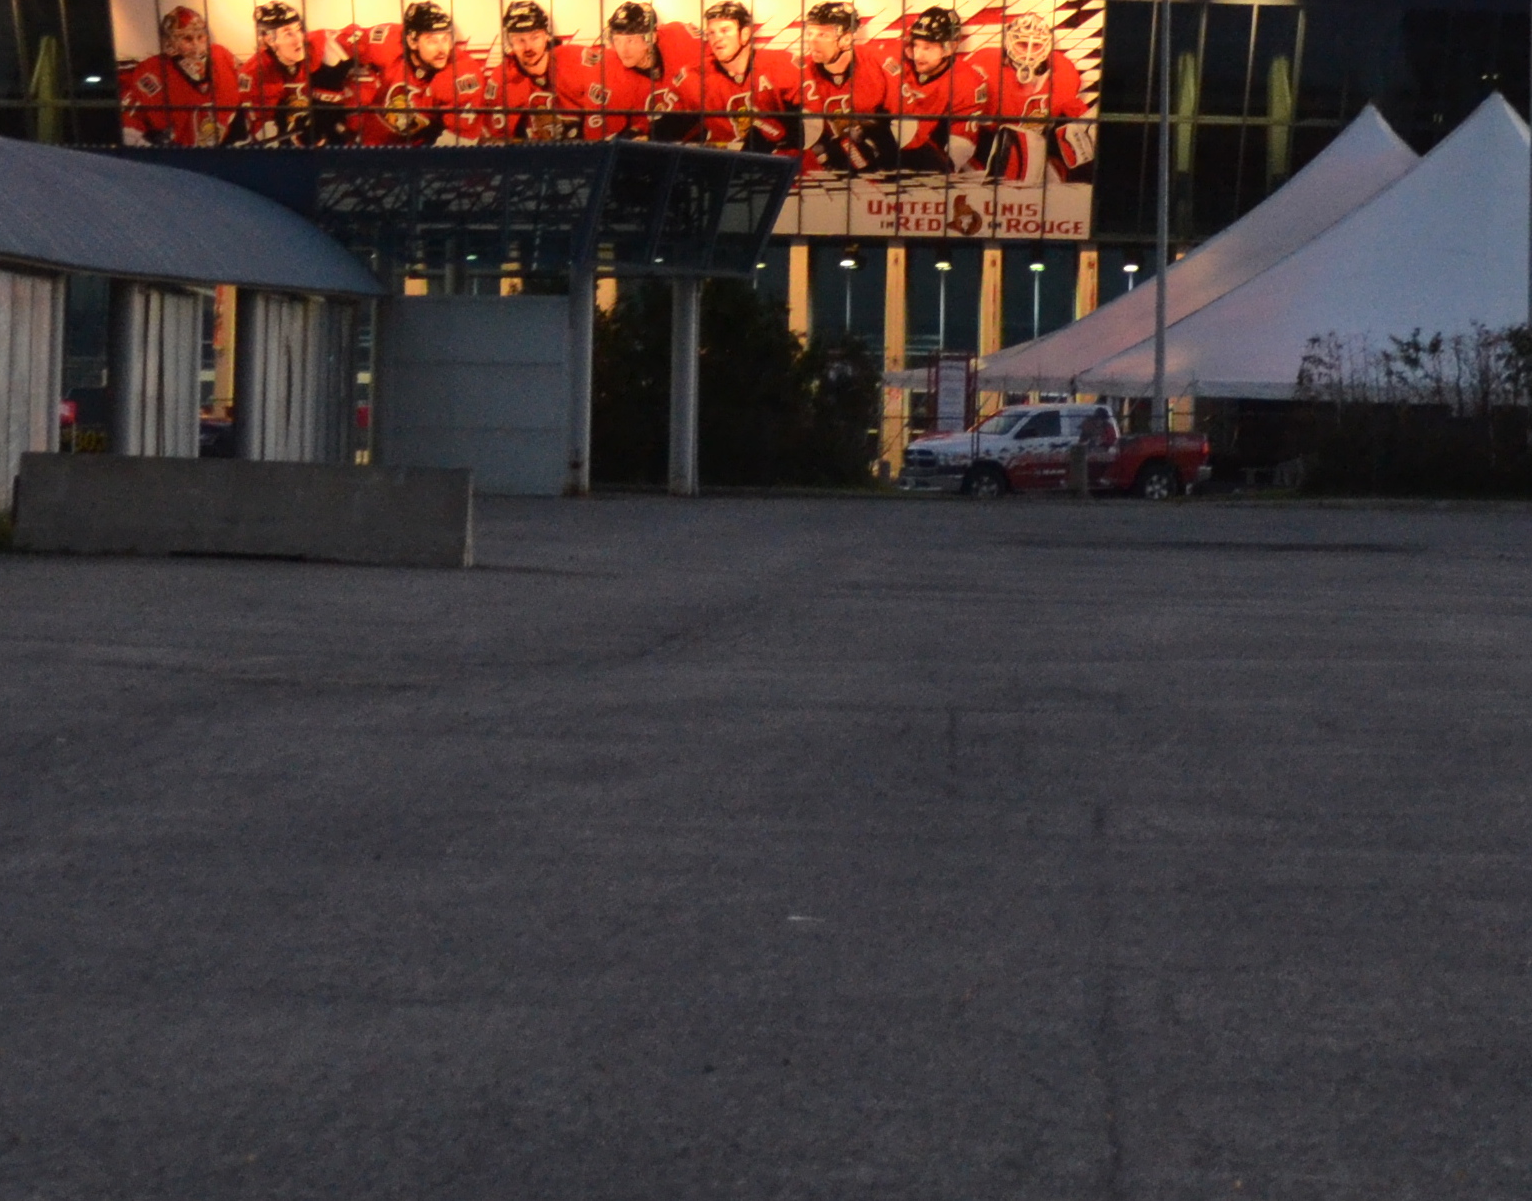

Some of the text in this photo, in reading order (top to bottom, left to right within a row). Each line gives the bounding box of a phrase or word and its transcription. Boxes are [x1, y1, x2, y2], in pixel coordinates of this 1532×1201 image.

[758, 75, 773, 92] A
[802, 80, 819, 101] 2
[867, 199, 947, 216] UNITED
[895, 215, 942, 232] RED
[1005, 217, 1084, 235] ROUGE
